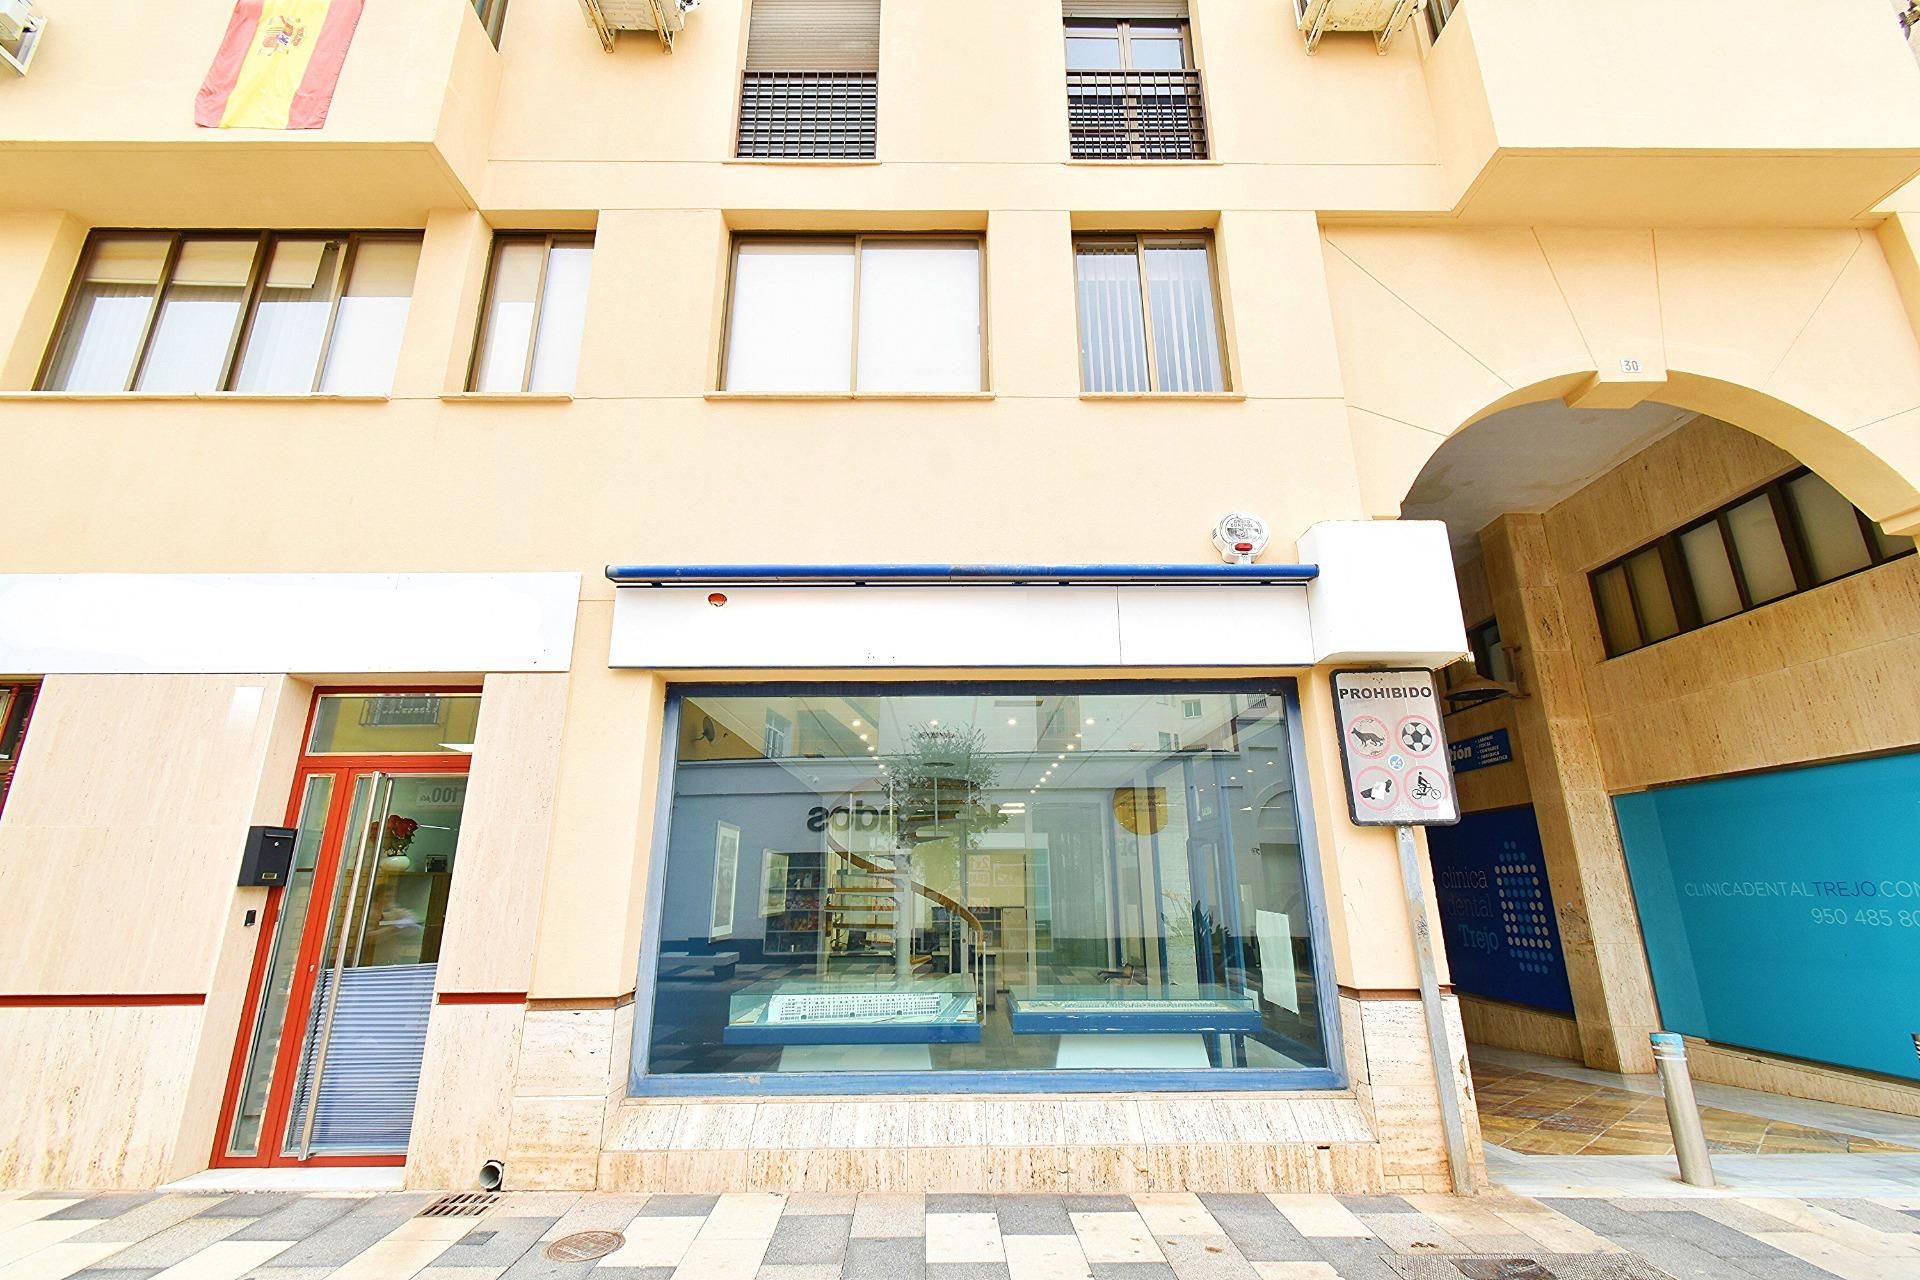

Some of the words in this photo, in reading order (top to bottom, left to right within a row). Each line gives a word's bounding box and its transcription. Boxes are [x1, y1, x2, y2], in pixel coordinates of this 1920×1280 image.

[1624, 360, 1639, 371] 30
[1339, 686, 1432, 700] PROHIBIDO
[1447, 893, 1494, 918] dental
[1810, 908, 1848, 926] 950
[1854, 909, 1894, 927] 485
[1458, 924, 1499, 954] Trejo
